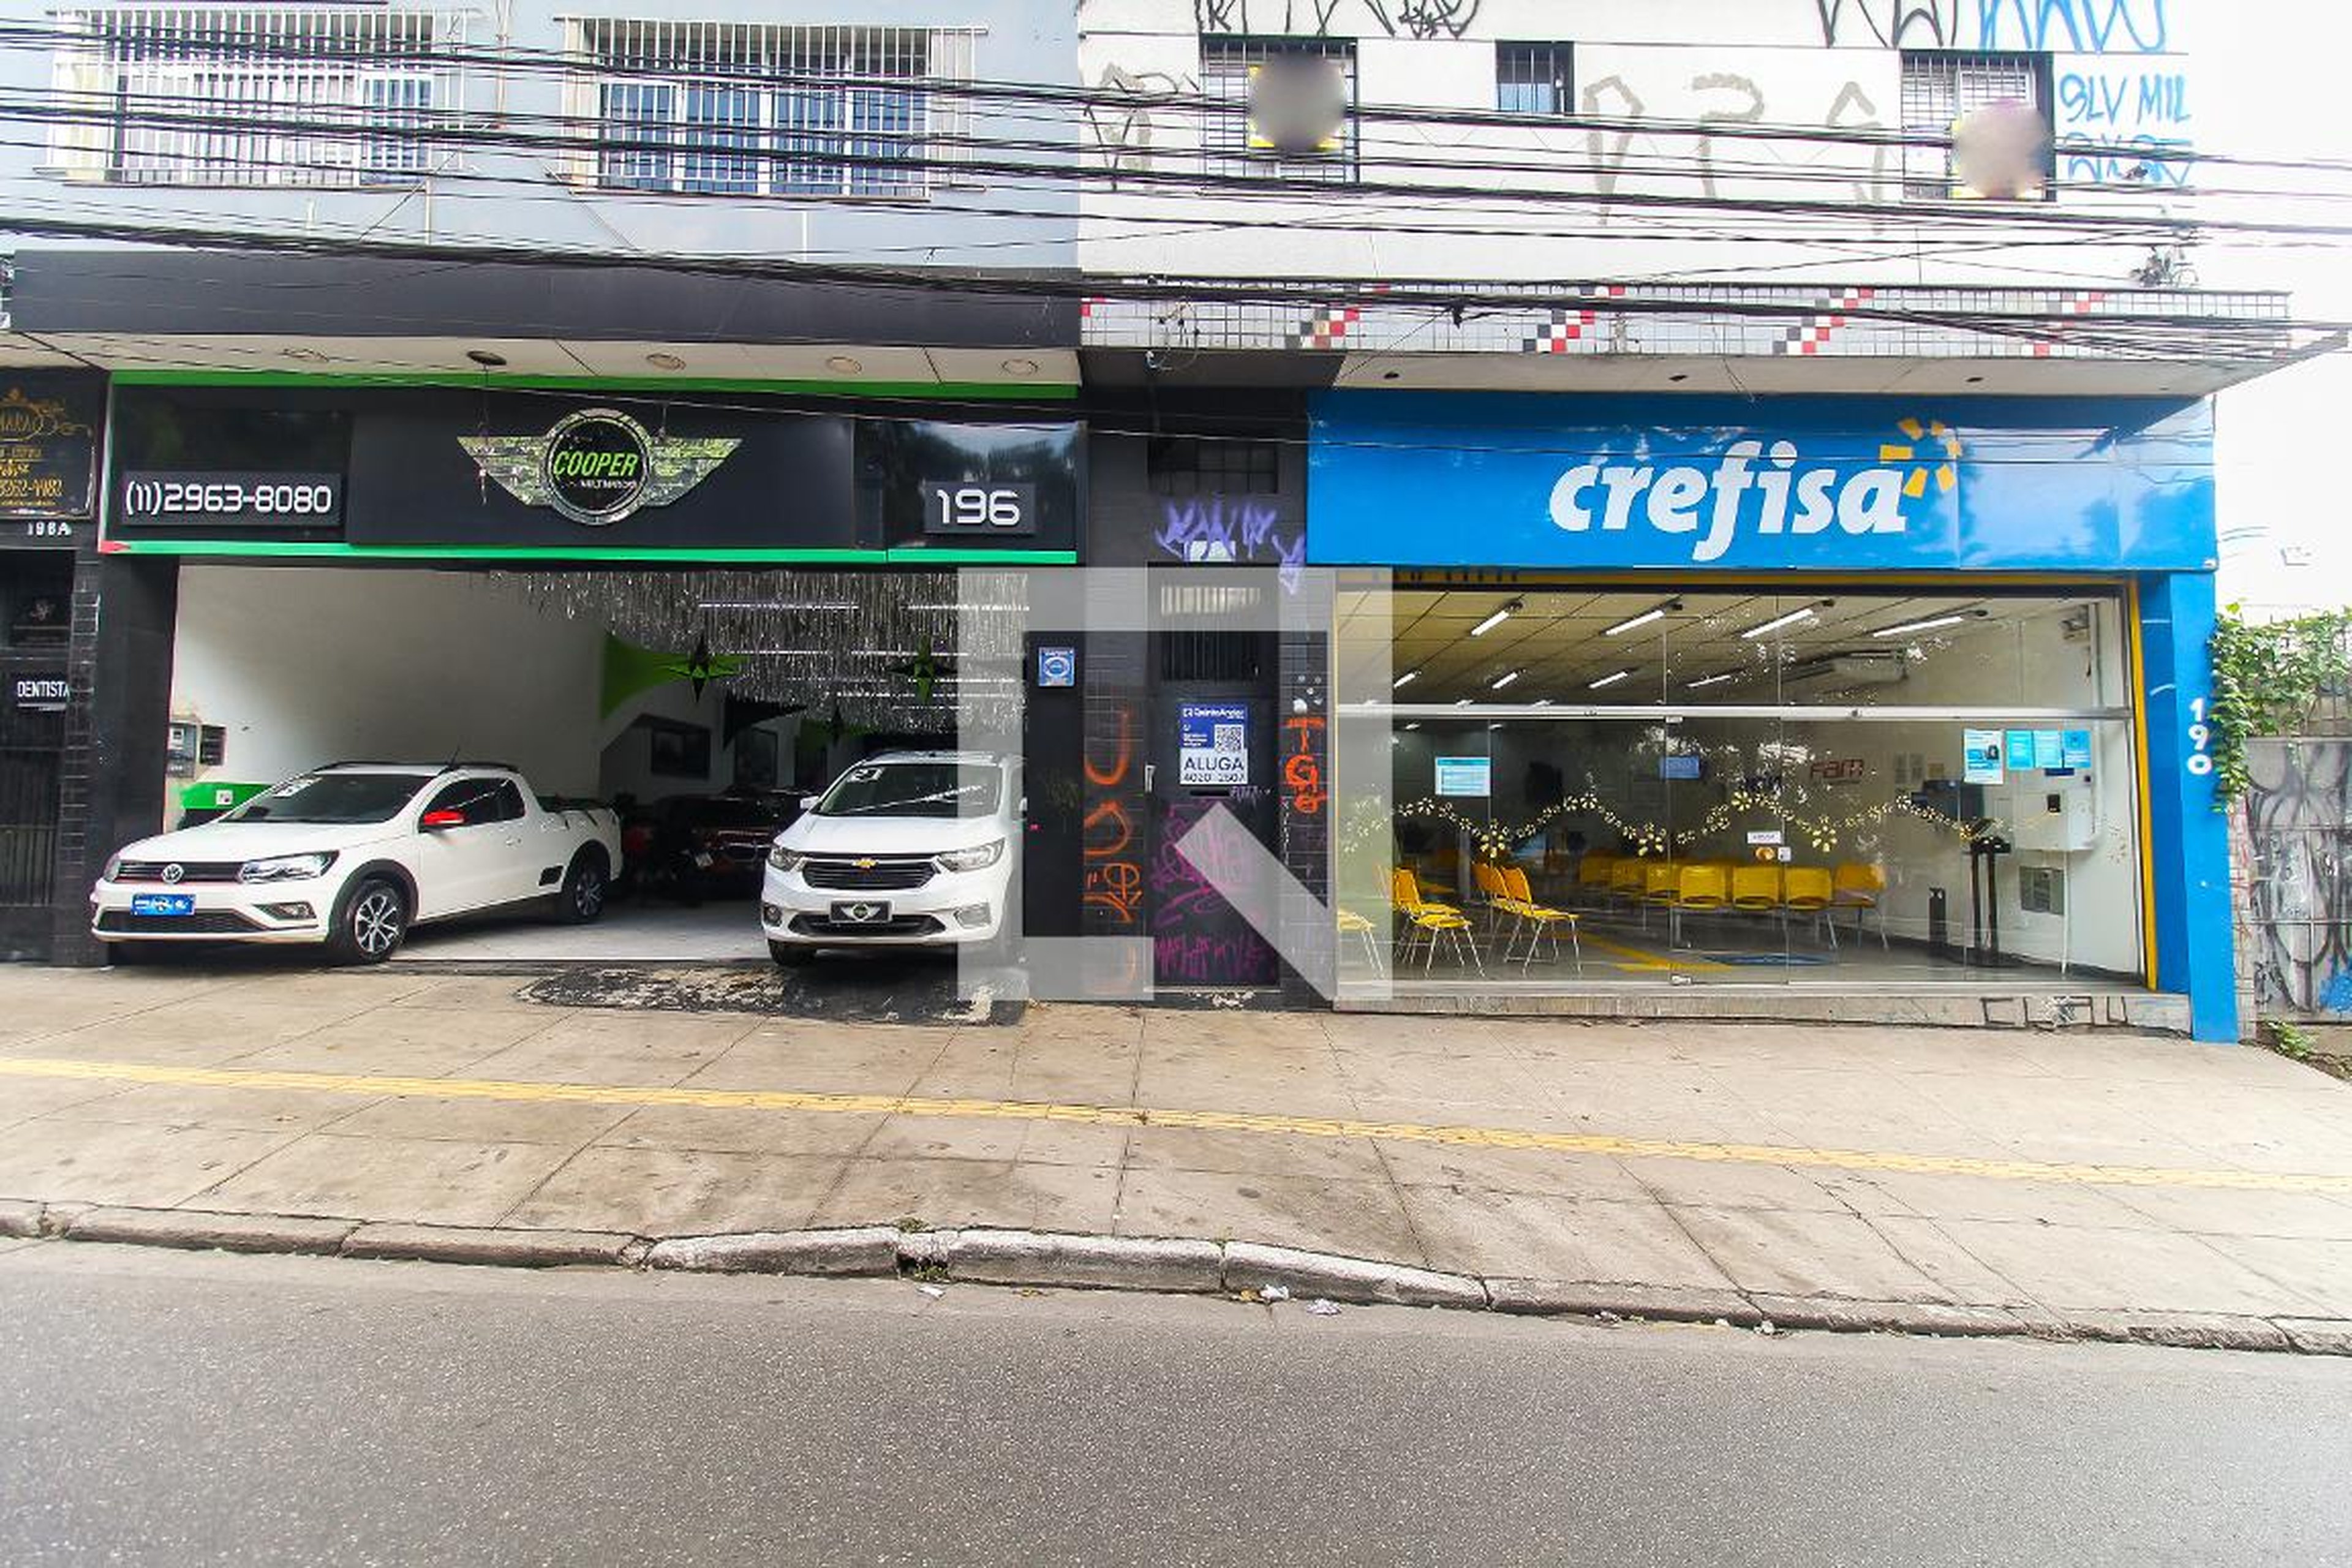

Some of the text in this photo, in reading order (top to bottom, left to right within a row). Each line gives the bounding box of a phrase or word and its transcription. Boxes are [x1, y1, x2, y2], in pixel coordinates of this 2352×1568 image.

[2137, 73, 2192, 125] MIL
[553, 451, 639, 477] COOPER
[126, 481, 332, 515] (11)2963-8080
[937, 489, 1020, 526] 196
[1549, 440, 1906, 561] crefisa
[17, 680, 70, 698] DENTISTA
[2187, 698, 2213, 775] 190
[1183, 757, 1245, 771] ALUGA
